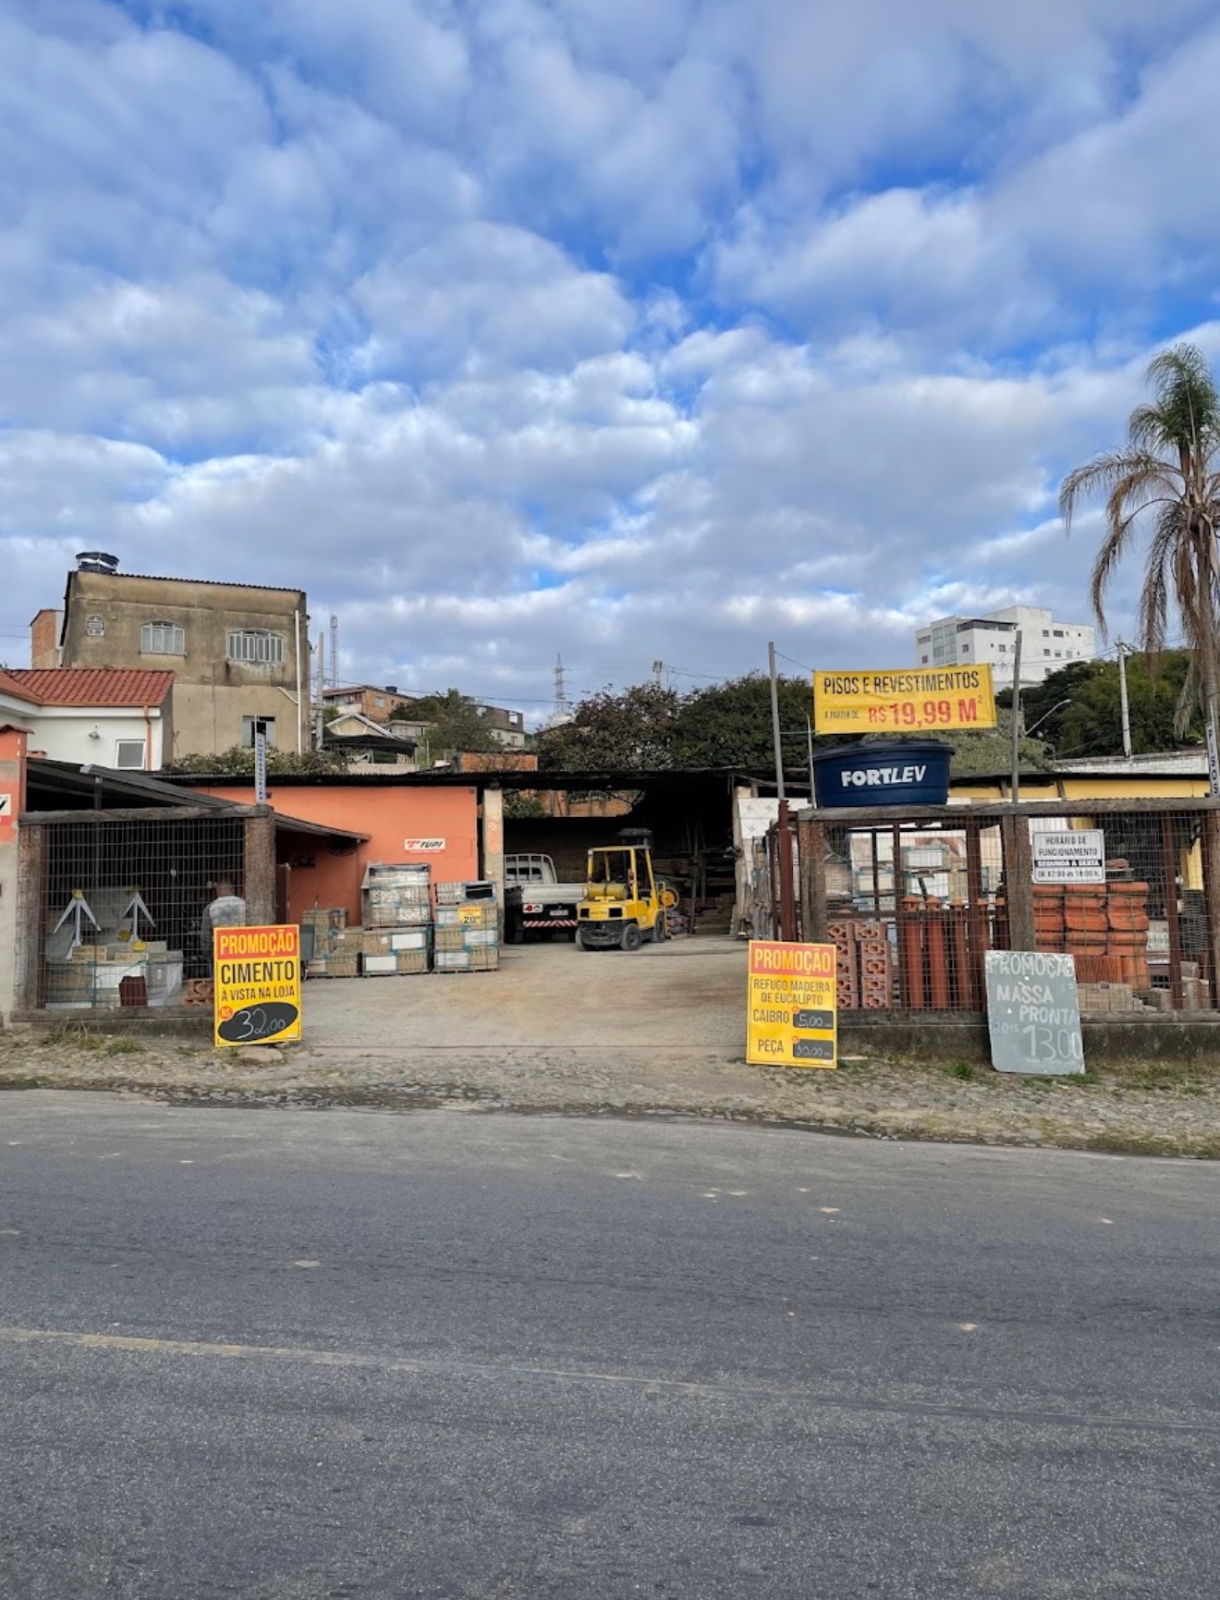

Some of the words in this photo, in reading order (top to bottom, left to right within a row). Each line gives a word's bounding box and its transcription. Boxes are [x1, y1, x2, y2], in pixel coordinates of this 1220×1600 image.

[824, 677, 859, 695] PISOS
[863, 678, 870, 694] E
[874, 671, 979, 694] REVESTIMENTOS
[868, 706, 887, 723] R$
[889, 699, 951, 728] 19,99
[1208, 728, 1219, 794] PISOS
[841, 765, 927, 788] FORTLEV
[1038, 847, 1098, 856] FUNCIONAMENTO
[220, 929, 295, 956] PROMOÇÃO
[754, 947, 831, 976] PROMOÇÃO
[221, 960, 295, 985] CIMENTO
[230, 988, 256, 1001] VISTA
[258, 987, 271, 998] NA
[274, 985, 295, 998] LOJA
[753, 979, 788, 991] REFUGO
[790, 981, 830, 992] MADEIRA
[996, 984, 1055, 1005] MASSA
[761, 992, 771, 1003] DE
[753, 1009, 790, 1024] CAIBRO
[1019, 1005, 1079, 1025] PRONTA
[758, 1038, 784, 1055] PEÇA
